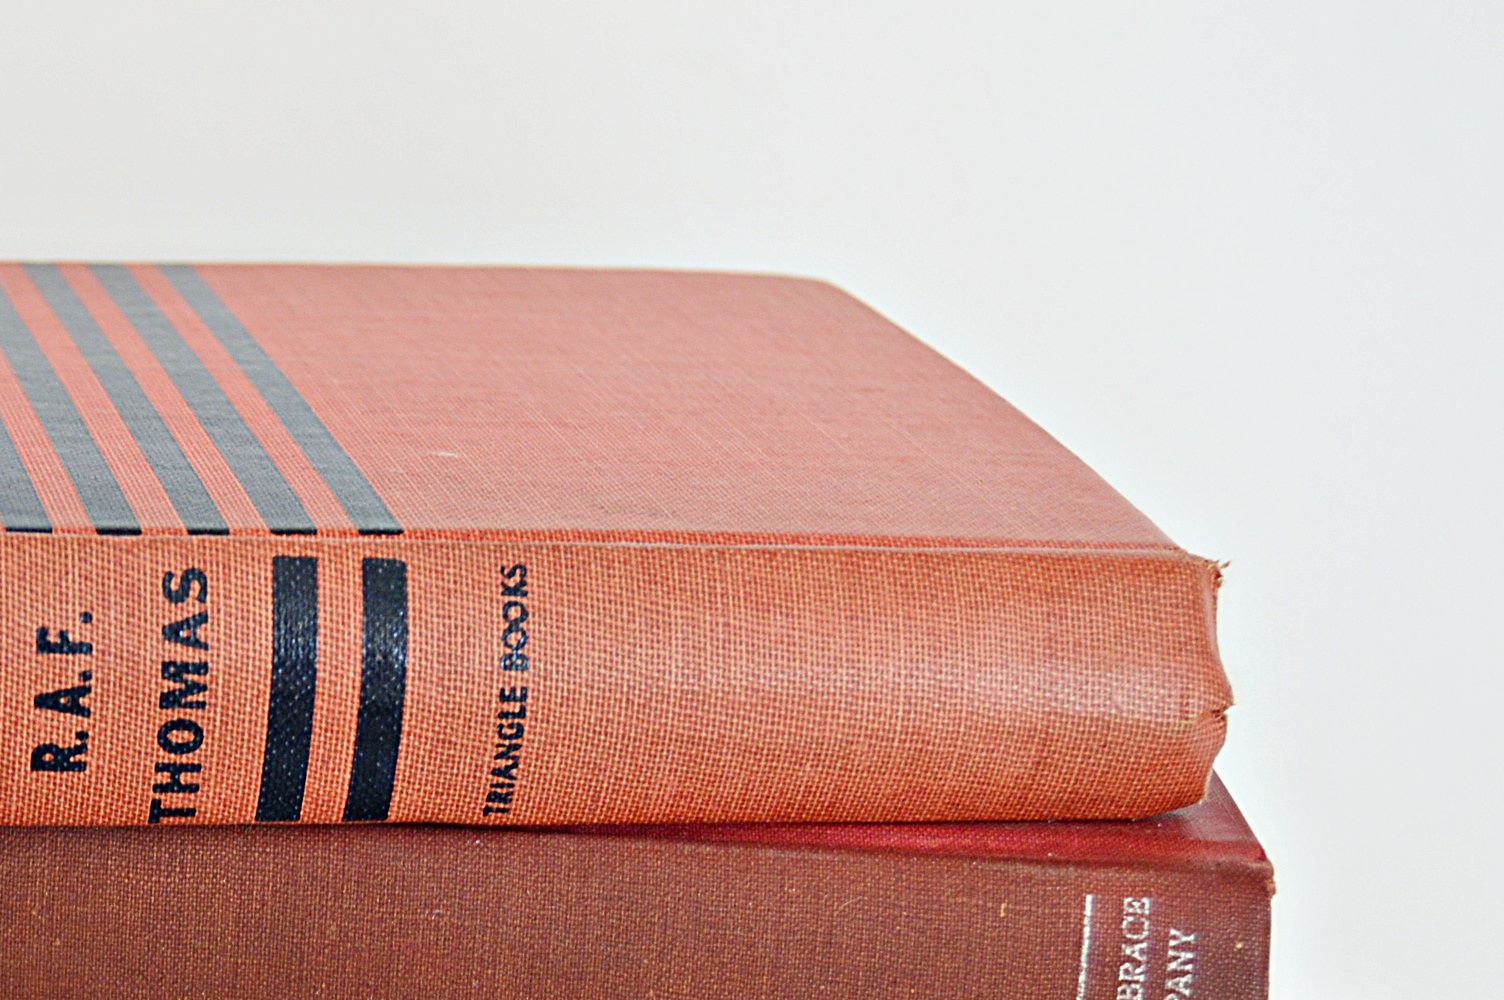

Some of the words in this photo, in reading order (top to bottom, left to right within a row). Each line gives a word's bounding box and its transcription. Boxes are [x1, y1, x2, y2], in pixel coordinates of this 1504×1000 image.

[501, 562, 529, 672] BOOKS
[30, 611, 93, 774] R.A.F.
[149, 566, 208, 823] THOMAS
[483, 684, 529, 819] TRIANGLE
